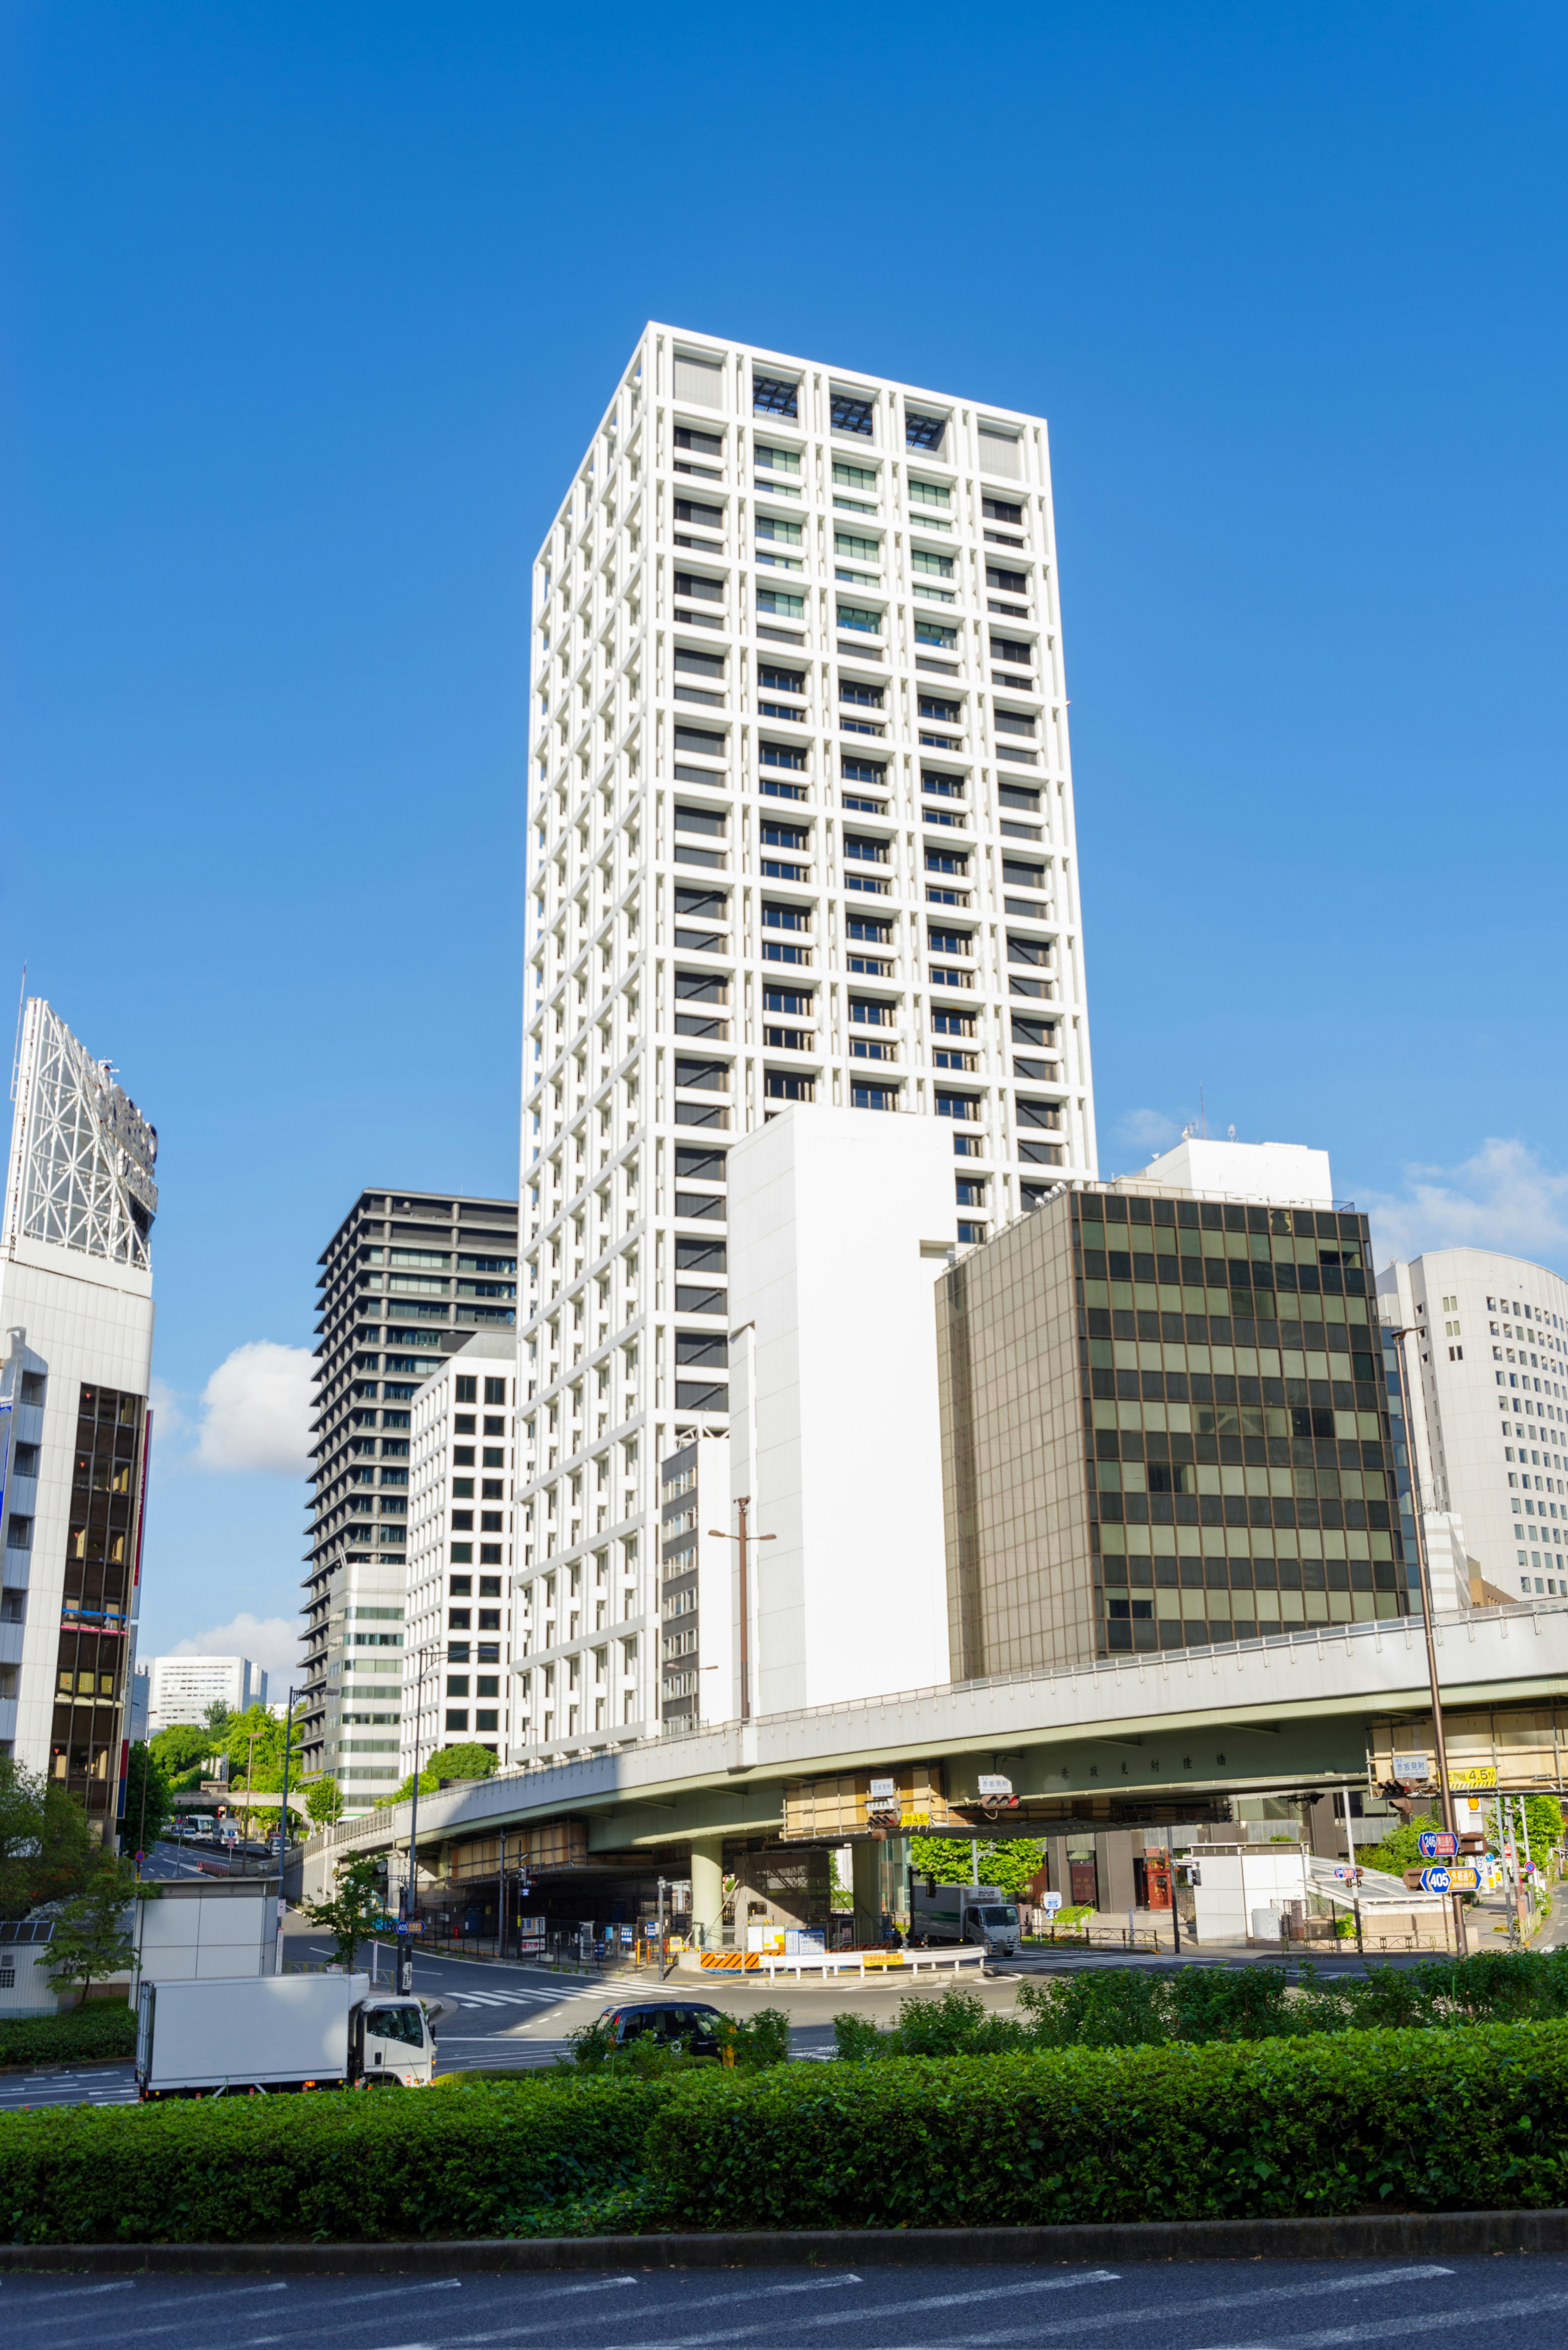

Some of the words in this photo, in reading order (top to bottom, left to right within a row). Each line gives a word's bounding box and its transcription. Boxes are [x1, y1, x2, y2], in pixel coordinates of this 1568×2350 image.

[1060, 1753, 1226, 1780] 赤坂見附陸橋
[1396, 1762, 1425, 1771] 赤坂見附
[1425, 1835, 1436, 1848] 246
[1437, 1836, 1452, 1847] 青山通り
[1430, 1873, 1449, 1888] 405
[1451, 1871, 1474, 1882] 外堀通り
